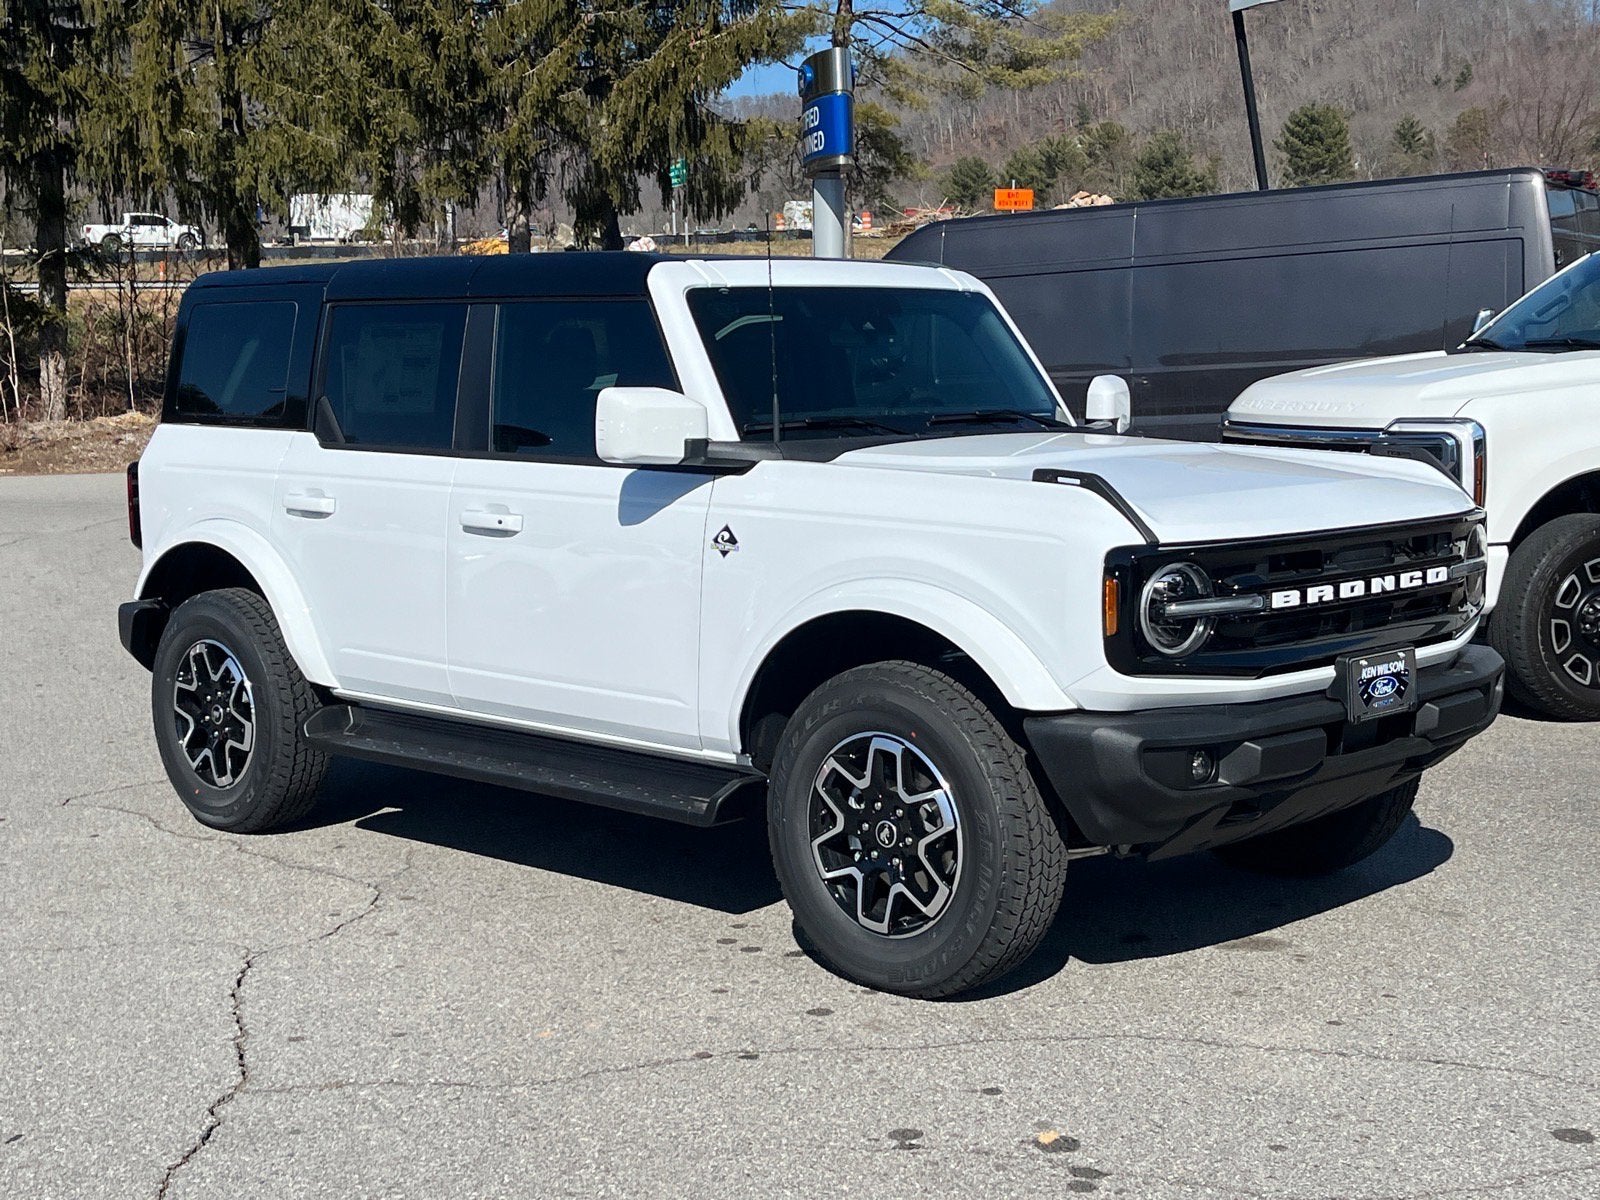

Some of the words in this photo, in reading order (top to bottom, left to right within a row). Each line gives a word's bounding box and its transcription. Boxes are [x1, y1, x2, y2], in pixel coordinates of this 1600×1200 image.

[1271, 566, 1448, 609] BRONCO
[1361, 665, 1377, 680] KEN
[1377, 659, 1405, 676] WILSON
[1374, 679, 1393, 696] Ford
